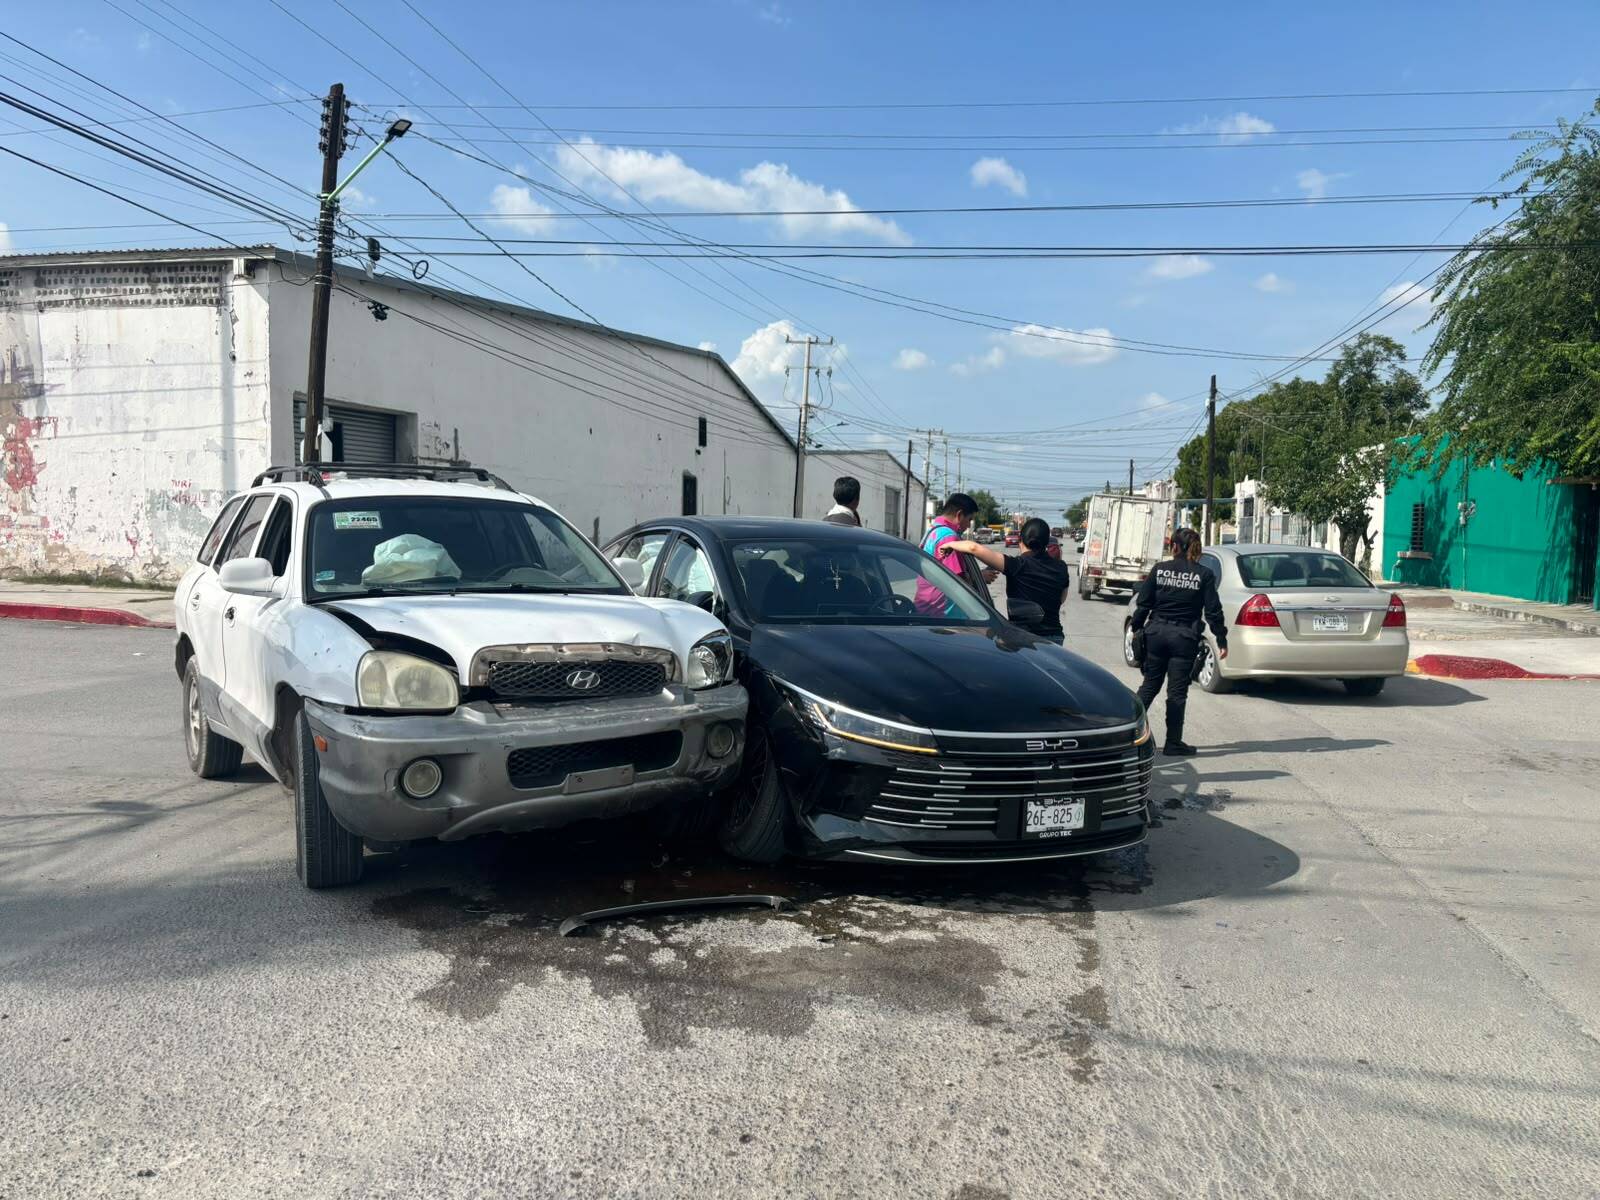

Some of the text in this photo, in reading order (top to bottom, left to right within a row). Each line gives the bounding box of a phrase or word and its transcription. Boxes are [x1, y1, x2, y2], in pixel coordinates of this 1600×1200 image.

[1156, 576, 1200, 590] MUNICIPAL
[1026, 739, 1079, 751] BYD
[1027, 807, 1072, 826] 26E-825
[1039, 831, 1060, 839] GRUPO
